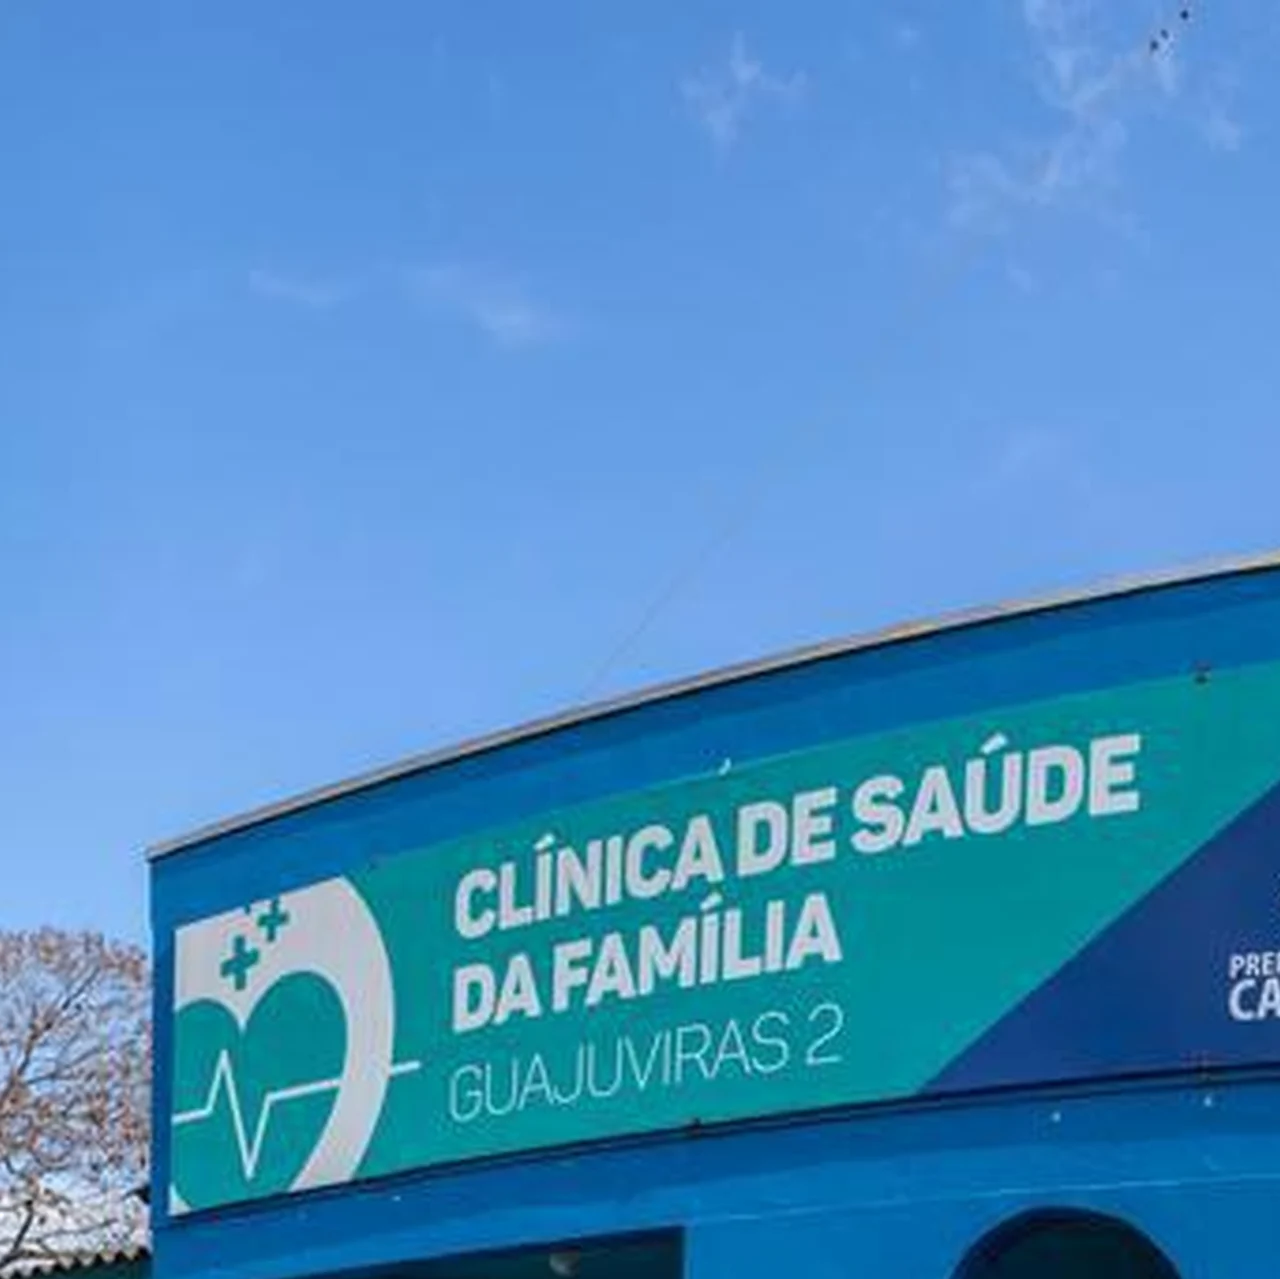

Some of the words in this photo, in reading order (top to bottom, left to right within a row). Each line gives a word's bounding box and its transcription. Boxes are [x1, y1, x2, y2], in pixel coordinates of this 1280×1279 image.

[454, 814, 725, 940] CLÍNICA
[735, 786, 839, 878] DE
[850, 731, 1142, 854] SAÚDE
[451, 952, 543, 1035] DA
[551, 892, 844, 1013] FAMÍLIA
[449, 1011, 791, 1123] GUAJUVIRAS
[805, 1003, 844, 1066] 2
